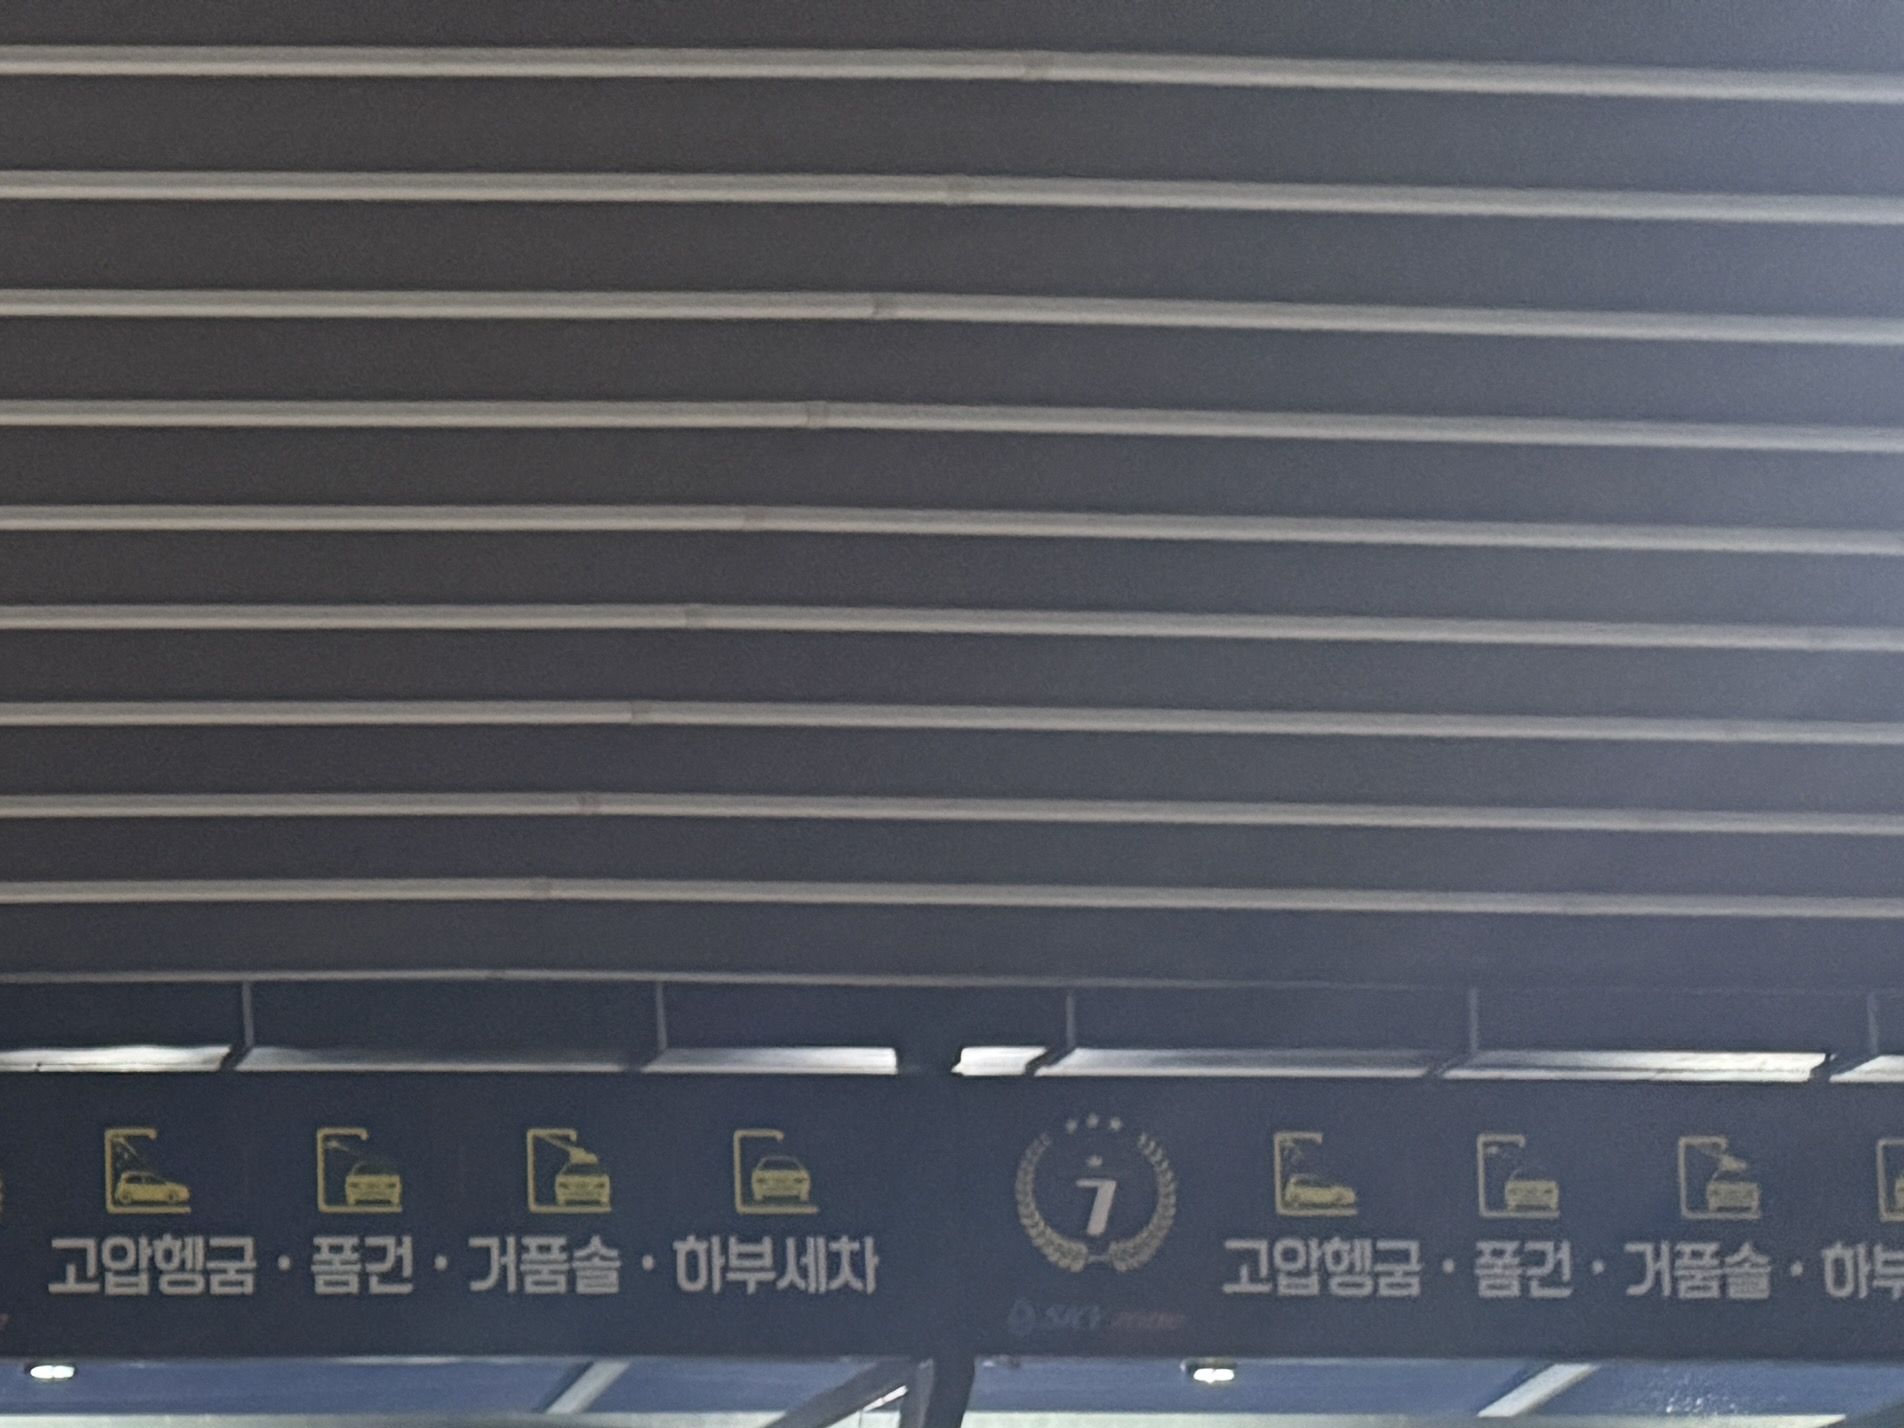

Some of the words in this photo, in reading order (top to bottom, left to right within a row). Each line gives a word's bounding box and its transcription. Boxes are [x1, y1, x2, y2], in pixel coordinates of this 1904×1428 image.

[1077, 1180, 1116, 1235] 7
[49, 1234, 257, 1295] 고압헹굼
[311, 1235, 413, 1294] 폼건
[469, 1236, 621, 1294] 거품솔
[673, 1235, 879, 1294] 하부세차
[1223, 1236, 1422, 1297] 고압헹굼
[1475, 1240, 1572, 1298] 폼건
[1624, 1241, 1772, 1299] 거품솔
